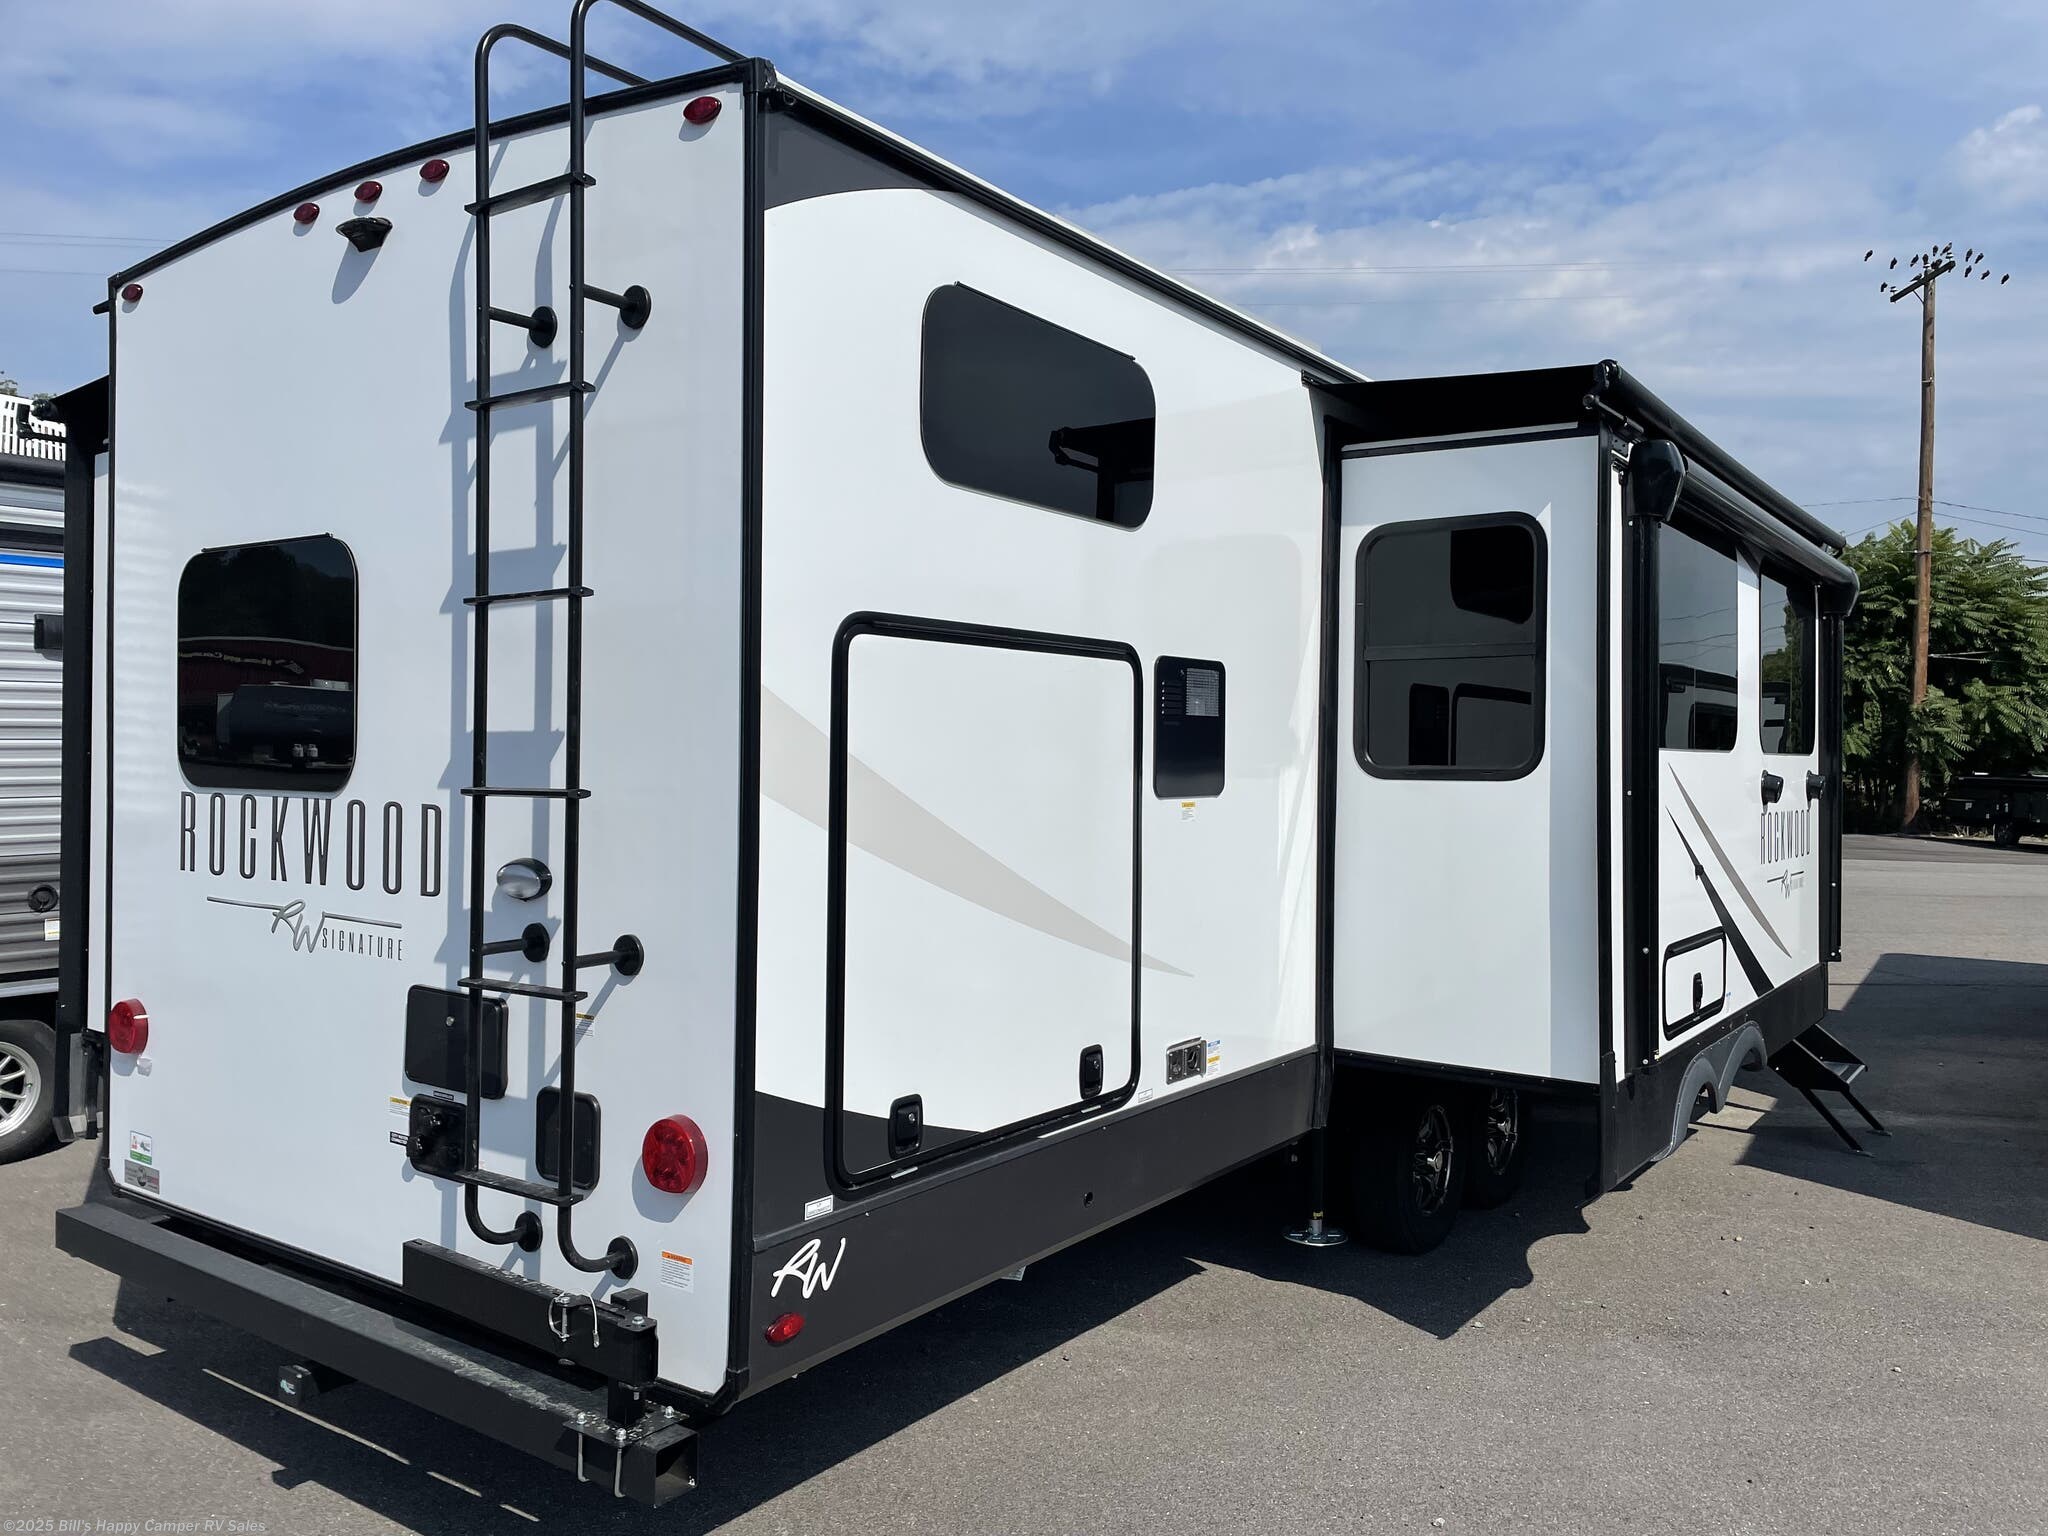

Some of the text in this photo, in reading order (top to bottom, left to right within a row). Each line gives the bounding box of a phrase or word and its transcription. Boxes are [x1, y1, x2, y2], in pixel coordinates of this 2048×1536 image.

[180, 791, 442, 897] ROCKWOOD
[1760, 809, 1811, 864] ROCKWOOD
[271, 899, 402, 961] RW SIGNATURE
